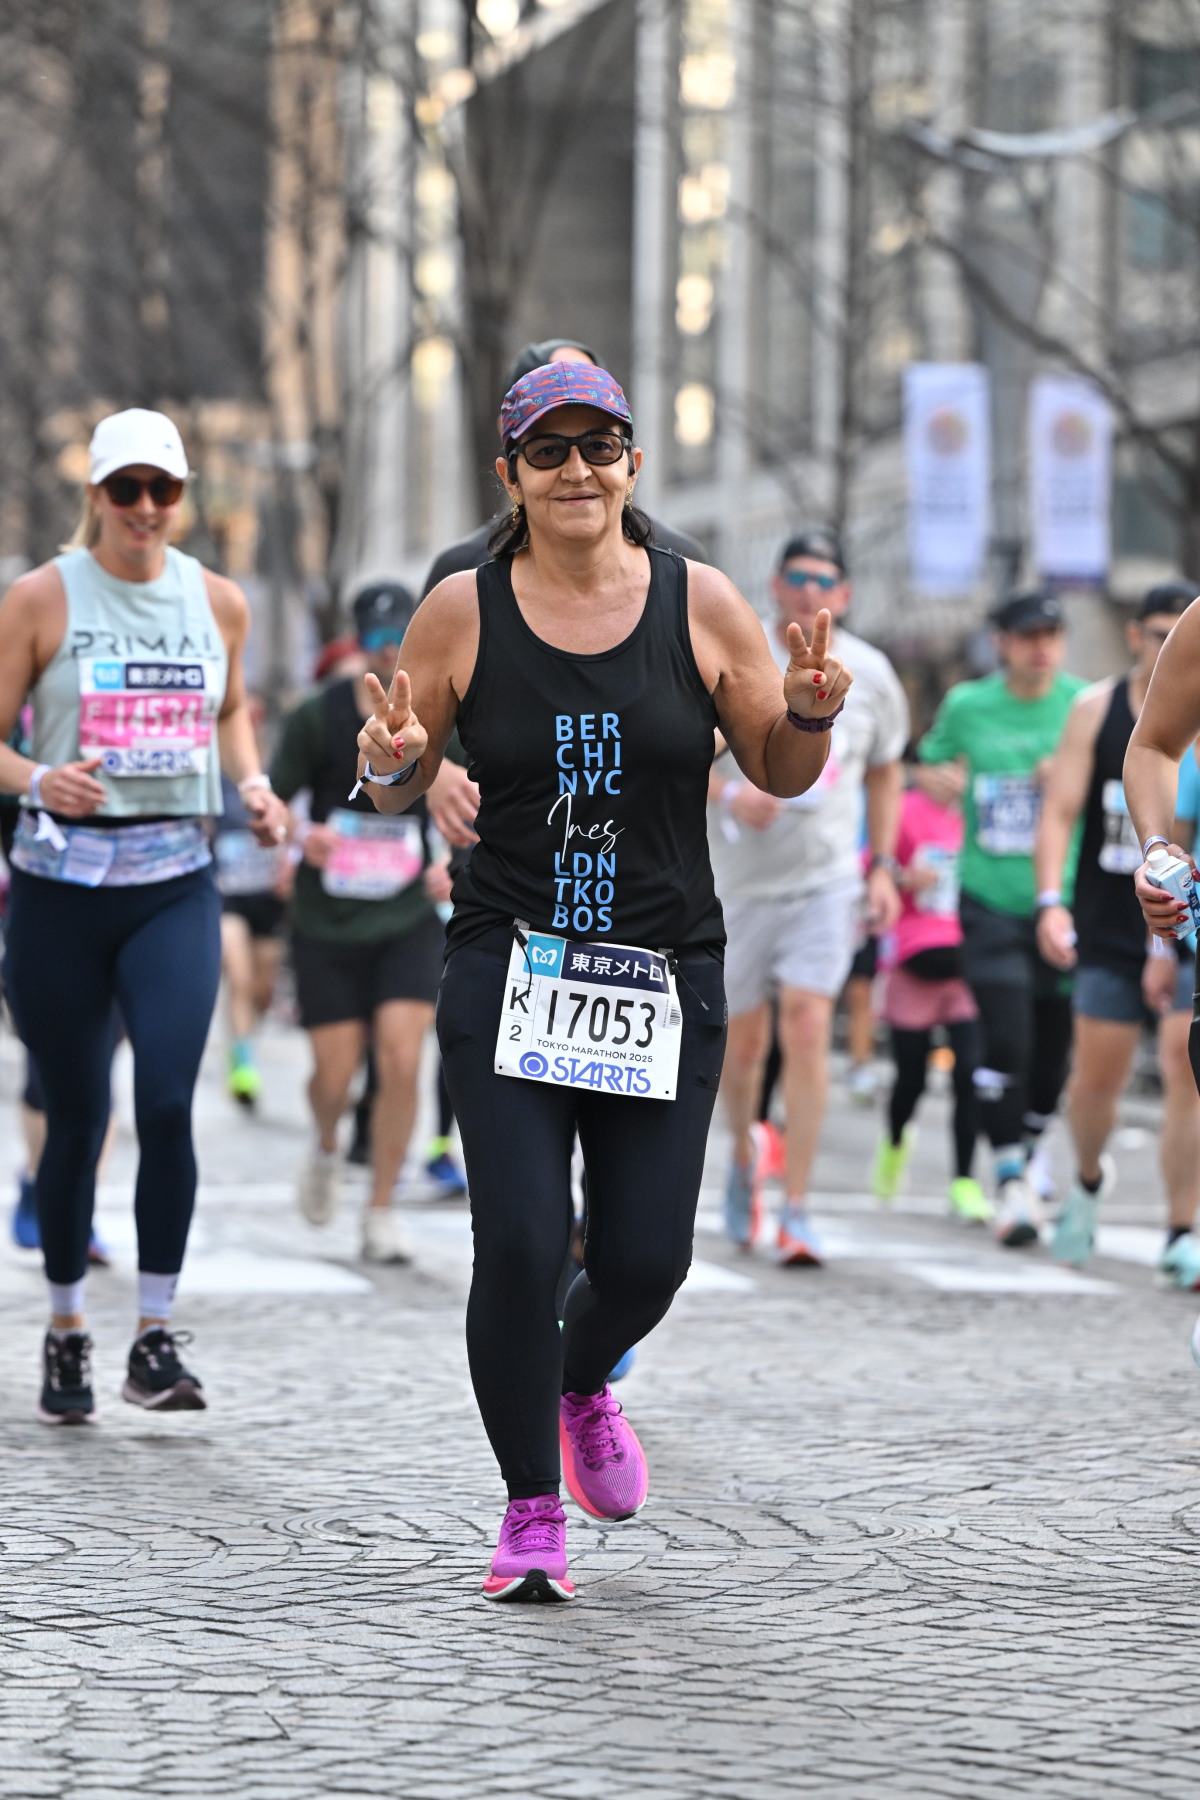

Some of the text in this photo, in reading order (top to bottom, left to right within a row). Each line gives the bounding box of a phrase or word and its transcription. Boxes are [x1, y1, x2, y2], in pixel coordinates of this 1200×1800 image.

[555, 713, 622, 741] BER
[556, 741, 621, 769] CHI
[558, 770, 623, 796] NYC
[547, 792, 626, 864] Ines
[554, 851, 616, 878] LDN
[553, 878, 614, 905] TKO
[551, 903, 613, 932] BOS
[570, 952, 664, 983] 東京メトロ
[509, 986, 531, 1014] K
[546, 989, 656, 1048] 17053
[509, 1024, 522, 1042] 2
[536, 1038, 653, 1063] TOKYO MARATHON 2025
